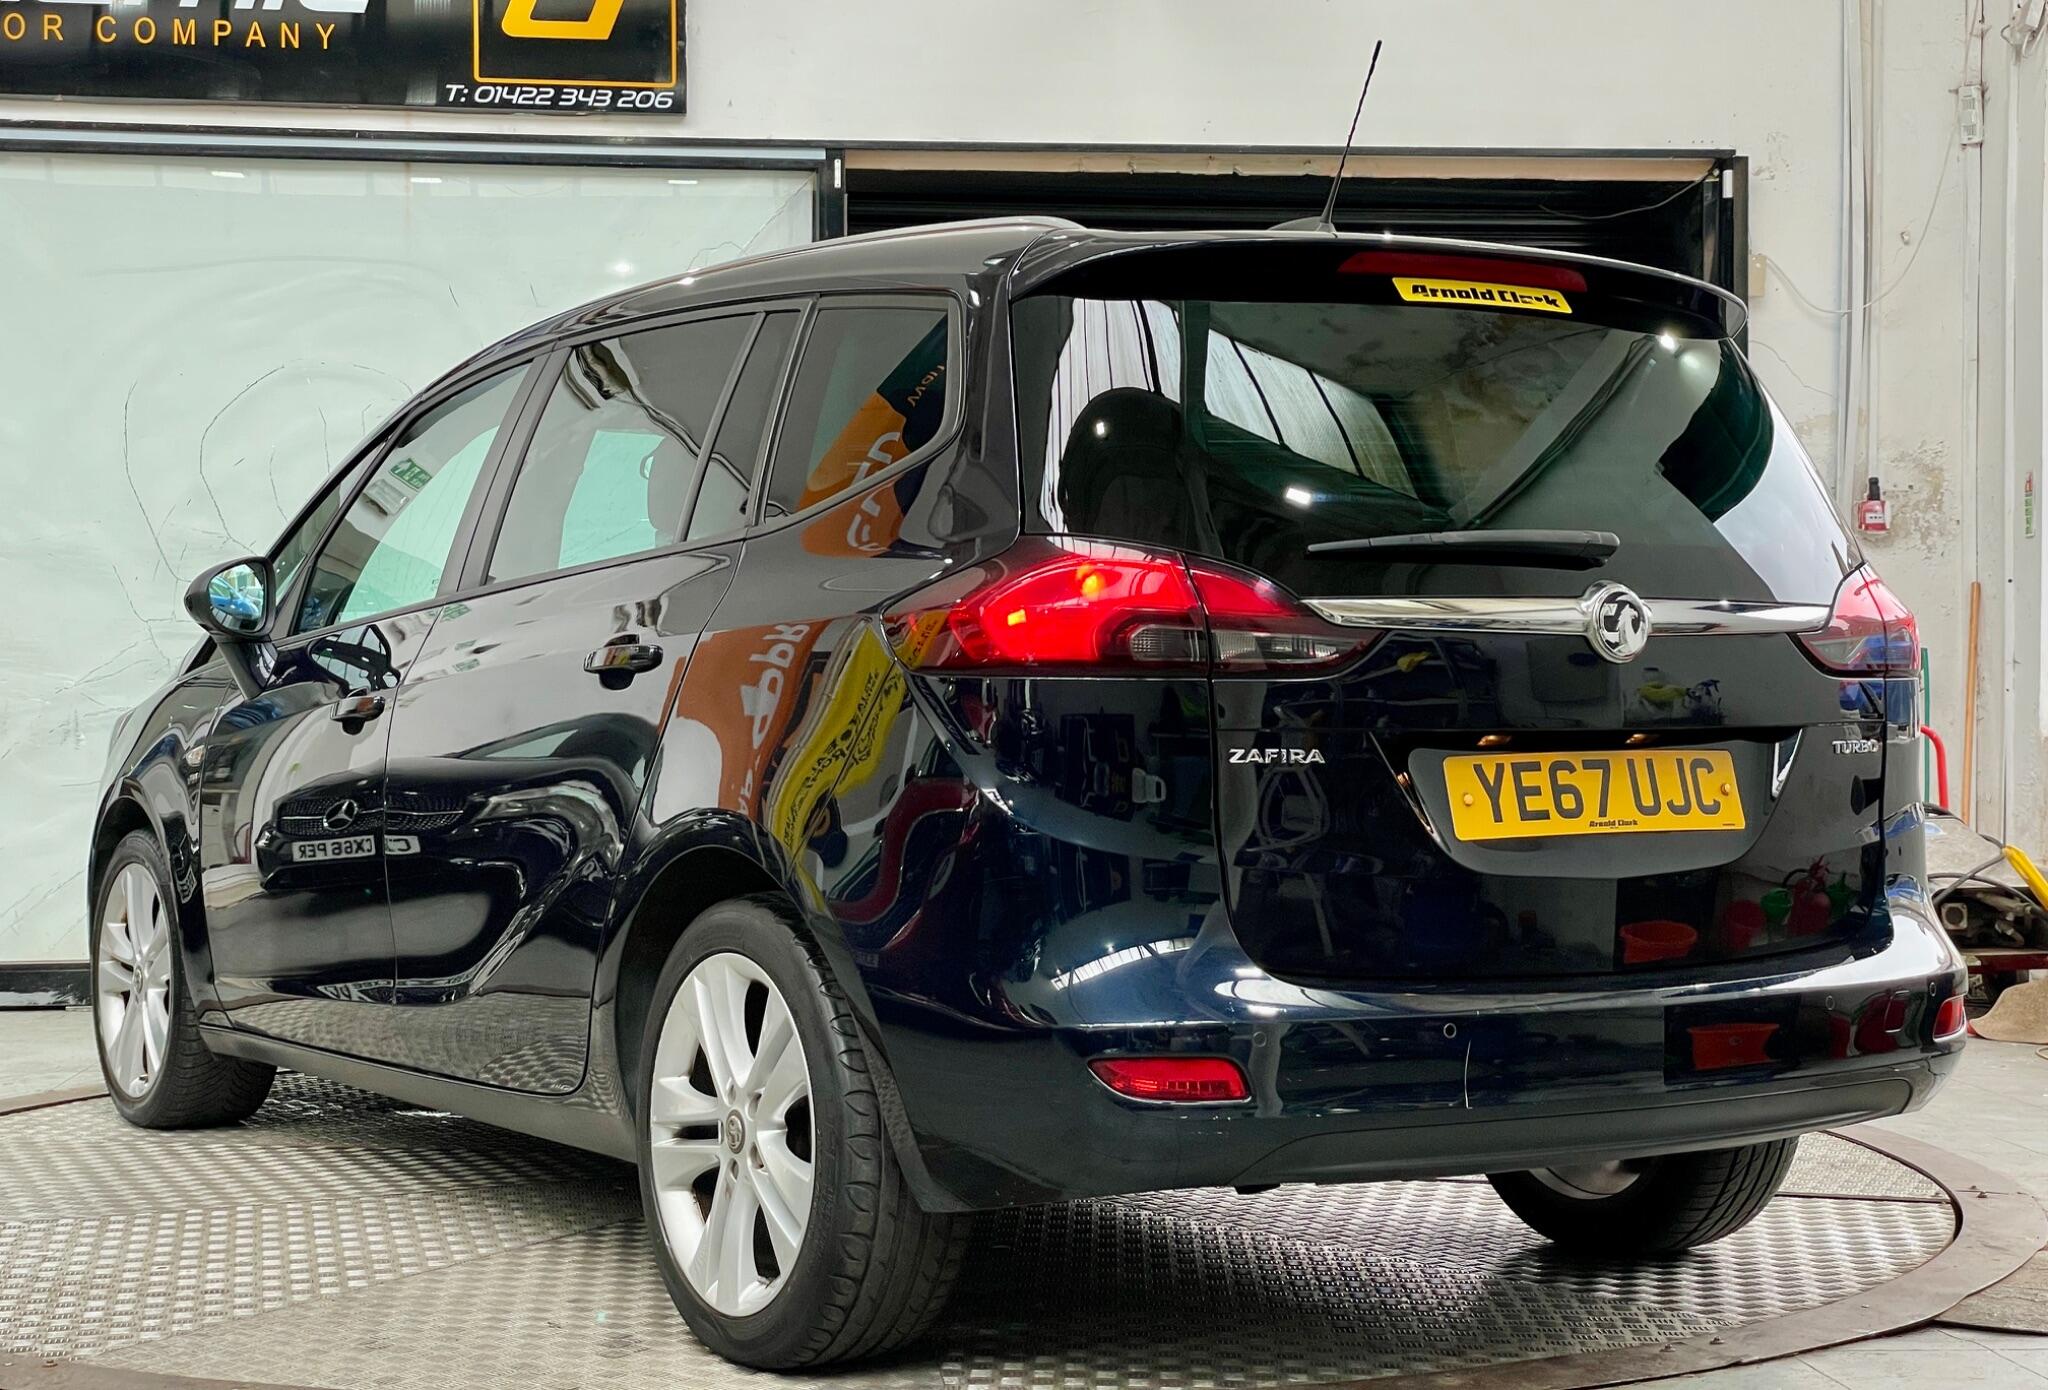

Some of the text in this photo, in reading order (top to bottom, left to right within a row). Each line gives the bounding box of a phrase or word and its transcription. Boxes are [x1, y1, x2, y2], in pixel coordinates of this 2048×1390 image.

[96, 15, 336, 50] COMPANY
[445, 84, 675, 109] T: 01422 343 206
[1411, 284, 1496, 302] Arnold
[1228, 748, 1326, 764] ZAFIRA
[1832, 738, 1879, 754] TURBO
[1472, 757, 1722, 824] YE67 UJC
